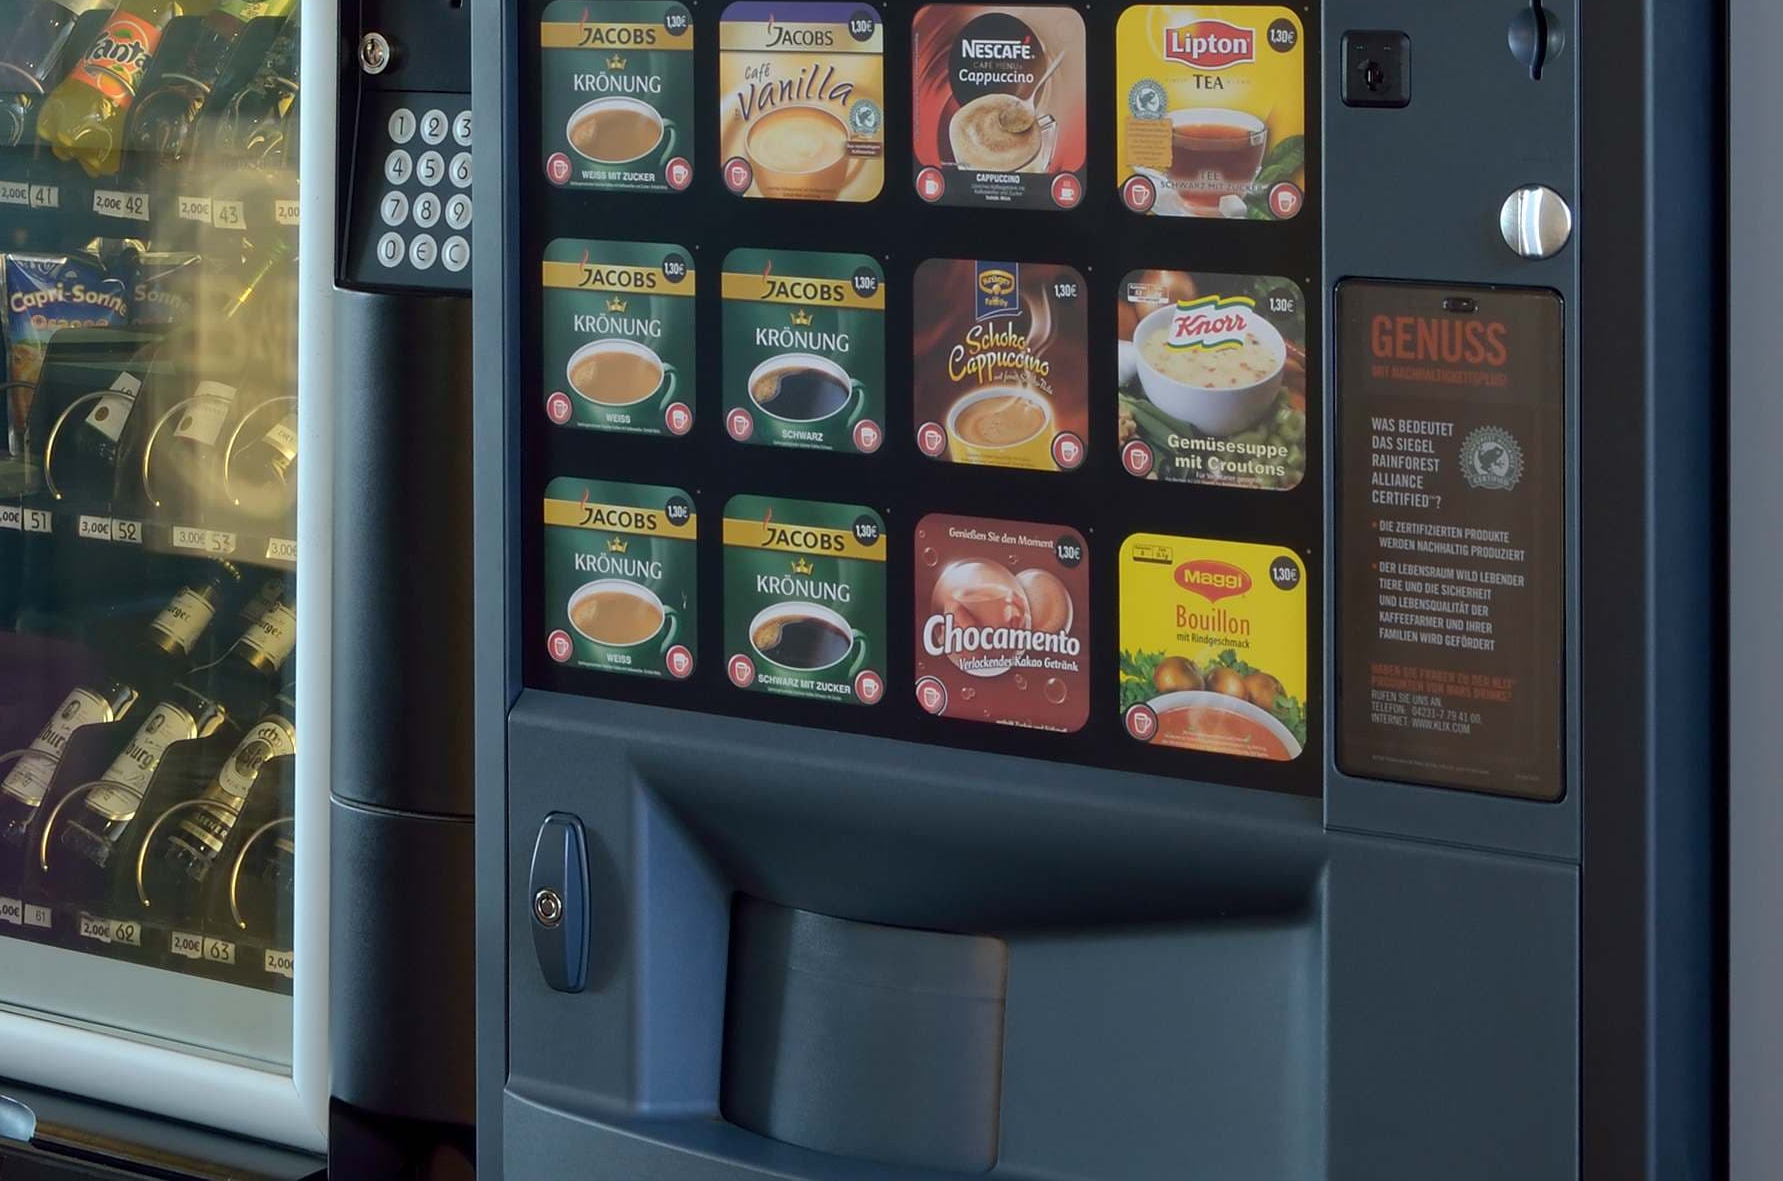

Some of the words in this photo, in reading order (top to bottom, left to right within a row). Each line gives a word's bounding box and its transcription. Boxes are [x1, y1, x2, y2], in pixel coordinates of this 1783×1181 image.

[766, 26, 834, 47] JACOBS
[961, 34, 1032, 60] NESCAFÉ
[1172, 32, 1248, 59] Lipton
[1270, 28, 1295, 44] 1,30€
[959, 68, 1034, 87] Cappuccino
[1193, 74, 1225, 90] TEA
[738, 63, 855, 121] Vanilla
[392, 157, 403, 177] 4
[424, 159, 435, 178] 5
[457, 160, 468, 180] 6
[976, 173, 1020, 184] CAPPUCCINO
[35, 186, 53, 204] 41
[125, 196, 144, 214] 42
[219, 205, 238, 224] 43
[390, 199, 400, 218] 7
[421, 200, 432, 220] 8
[453, 202, 465, 221] 9
[10, 282, 128, 317] Capri-Sonne
[761, 280, 845, 302] JACOBS
[1054, 283, 1077, 298] 1,30€
[1175, 311, 1247, 338] Knorr
[756, 326, 850, 353] KRÖNUNG
[965, 320, 1027, 356] Schoko
[1371, 314, 1508, 366] GENUSS
[948, 344, 1050, 385] Cappuccino
[782, 429, 824, 442] SCHWARZ
[1371, 417, 1396, 433] WAS
[1398, 419, 1454, 437] BEDEUTET
[1167, 433, 1289, 459] Gemüsesuppe
[1372, 435, 1393, 451] DAS
[1396, 436, 1435, 454] SIEGEL
[1175, 455, 1202, 470] mit
[1207, 456, 1285, 477] Croutons
[1372, 454, 1441, 473] RAINFOREST
[1371, 471, 1424, 490] ALLIANCE
[30, 512, 48, 529] 51
[119, 523, 137, 540] 52
[579, 507, 658, 531] JACOBS
[761, 527, 846, 552] JACOBS
[948, 527, 985, 542] Genießen
[987, 531, 1000, 543] Sie
[1001, 533, 1016, 545] den
[1018, 534, 1054, 550] Moment
[1379, 520, 1394, 532] DIE
[1395, 522, 1463, 539] ZERTIFIZIERTEN
[1464, 528, 1510, 544] PRODUKTE
[1379, 537, 1415, 551] WERDEN
[1417, 540, 1469, 556] NACHHALTIG
[1471, 545, 1525, 562] PRODUZIERT
[575, 552, 663, 580] KRÖNUNG
[756, 574, 851, 603] KRÖNUNG
[1175, 603, 1252, 638] Bouillon
[922, 614, 1082, 657] Chocamento
[1176, 632, 1189, 643] mit
[1191, 633, 1251, 650] Rindgeschmack
[959, 655, 1013, 671] Verlockendes
[1014, 655, 1042, 670] Kakao
[1044, 657, 1079, 673] Getränk
[758, 674, 799, 689] SCHWARZ
[800, 678, 815, 690] MIT
[816, 680, 852, 695] ZUCKER
[116, 924, 135, 941] 62
[210, 942, 230, 960] 63
